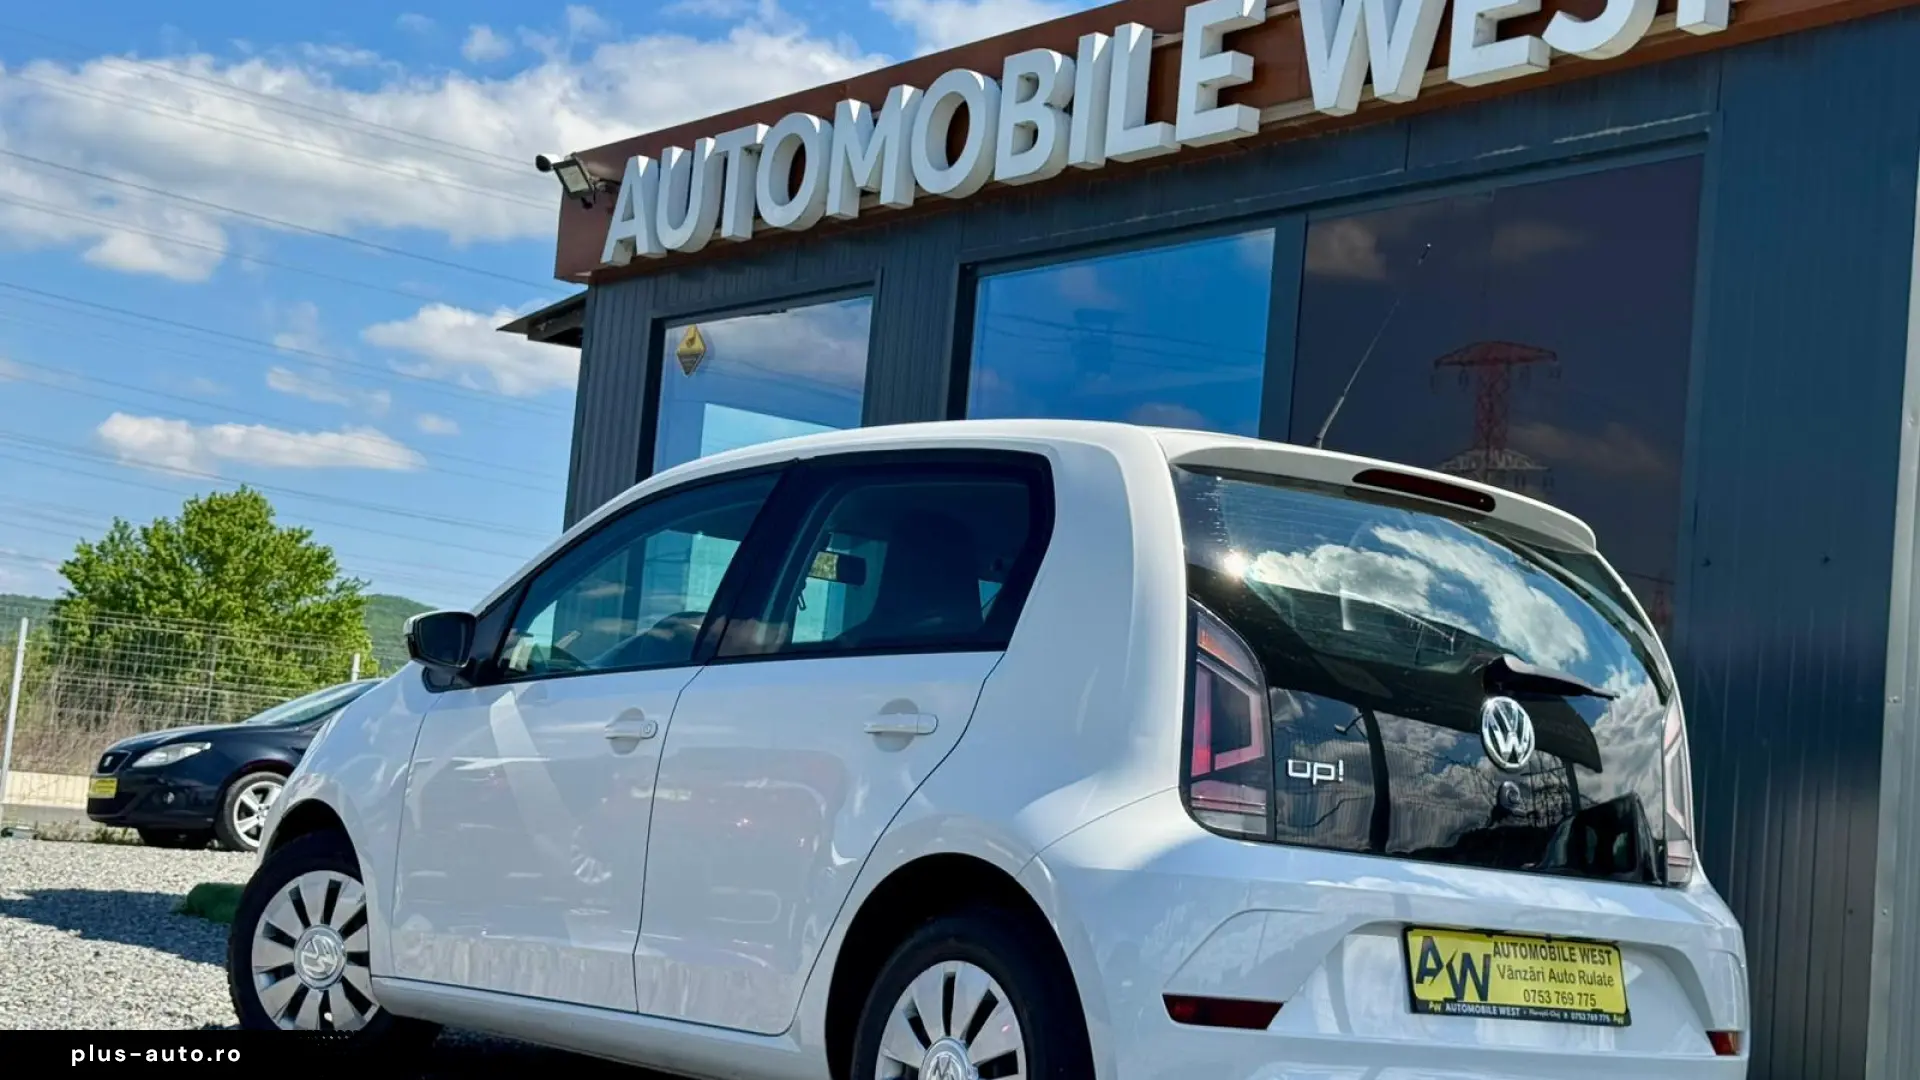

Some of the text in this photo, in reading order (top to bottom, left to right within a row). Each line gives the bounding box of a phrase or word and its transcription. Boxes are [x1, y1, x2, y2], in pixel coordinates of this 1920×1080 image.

[601, 0, 1729, 266] AUTOMOBILE WE
[1287, 758, 1344, 785] up!
[1493, 941, 1612, 966] AUTOMOBILE WEST
[1548, 968, 1576, 984] Auto
[1578, 970, 1616, 987] Rulate
[1523, 989, 1597, 1007] 0753 769 775
[1446, 1002, 1497, 1015] AUTOMOBILE
[1499, 1006, 1520, 1017] WEST
